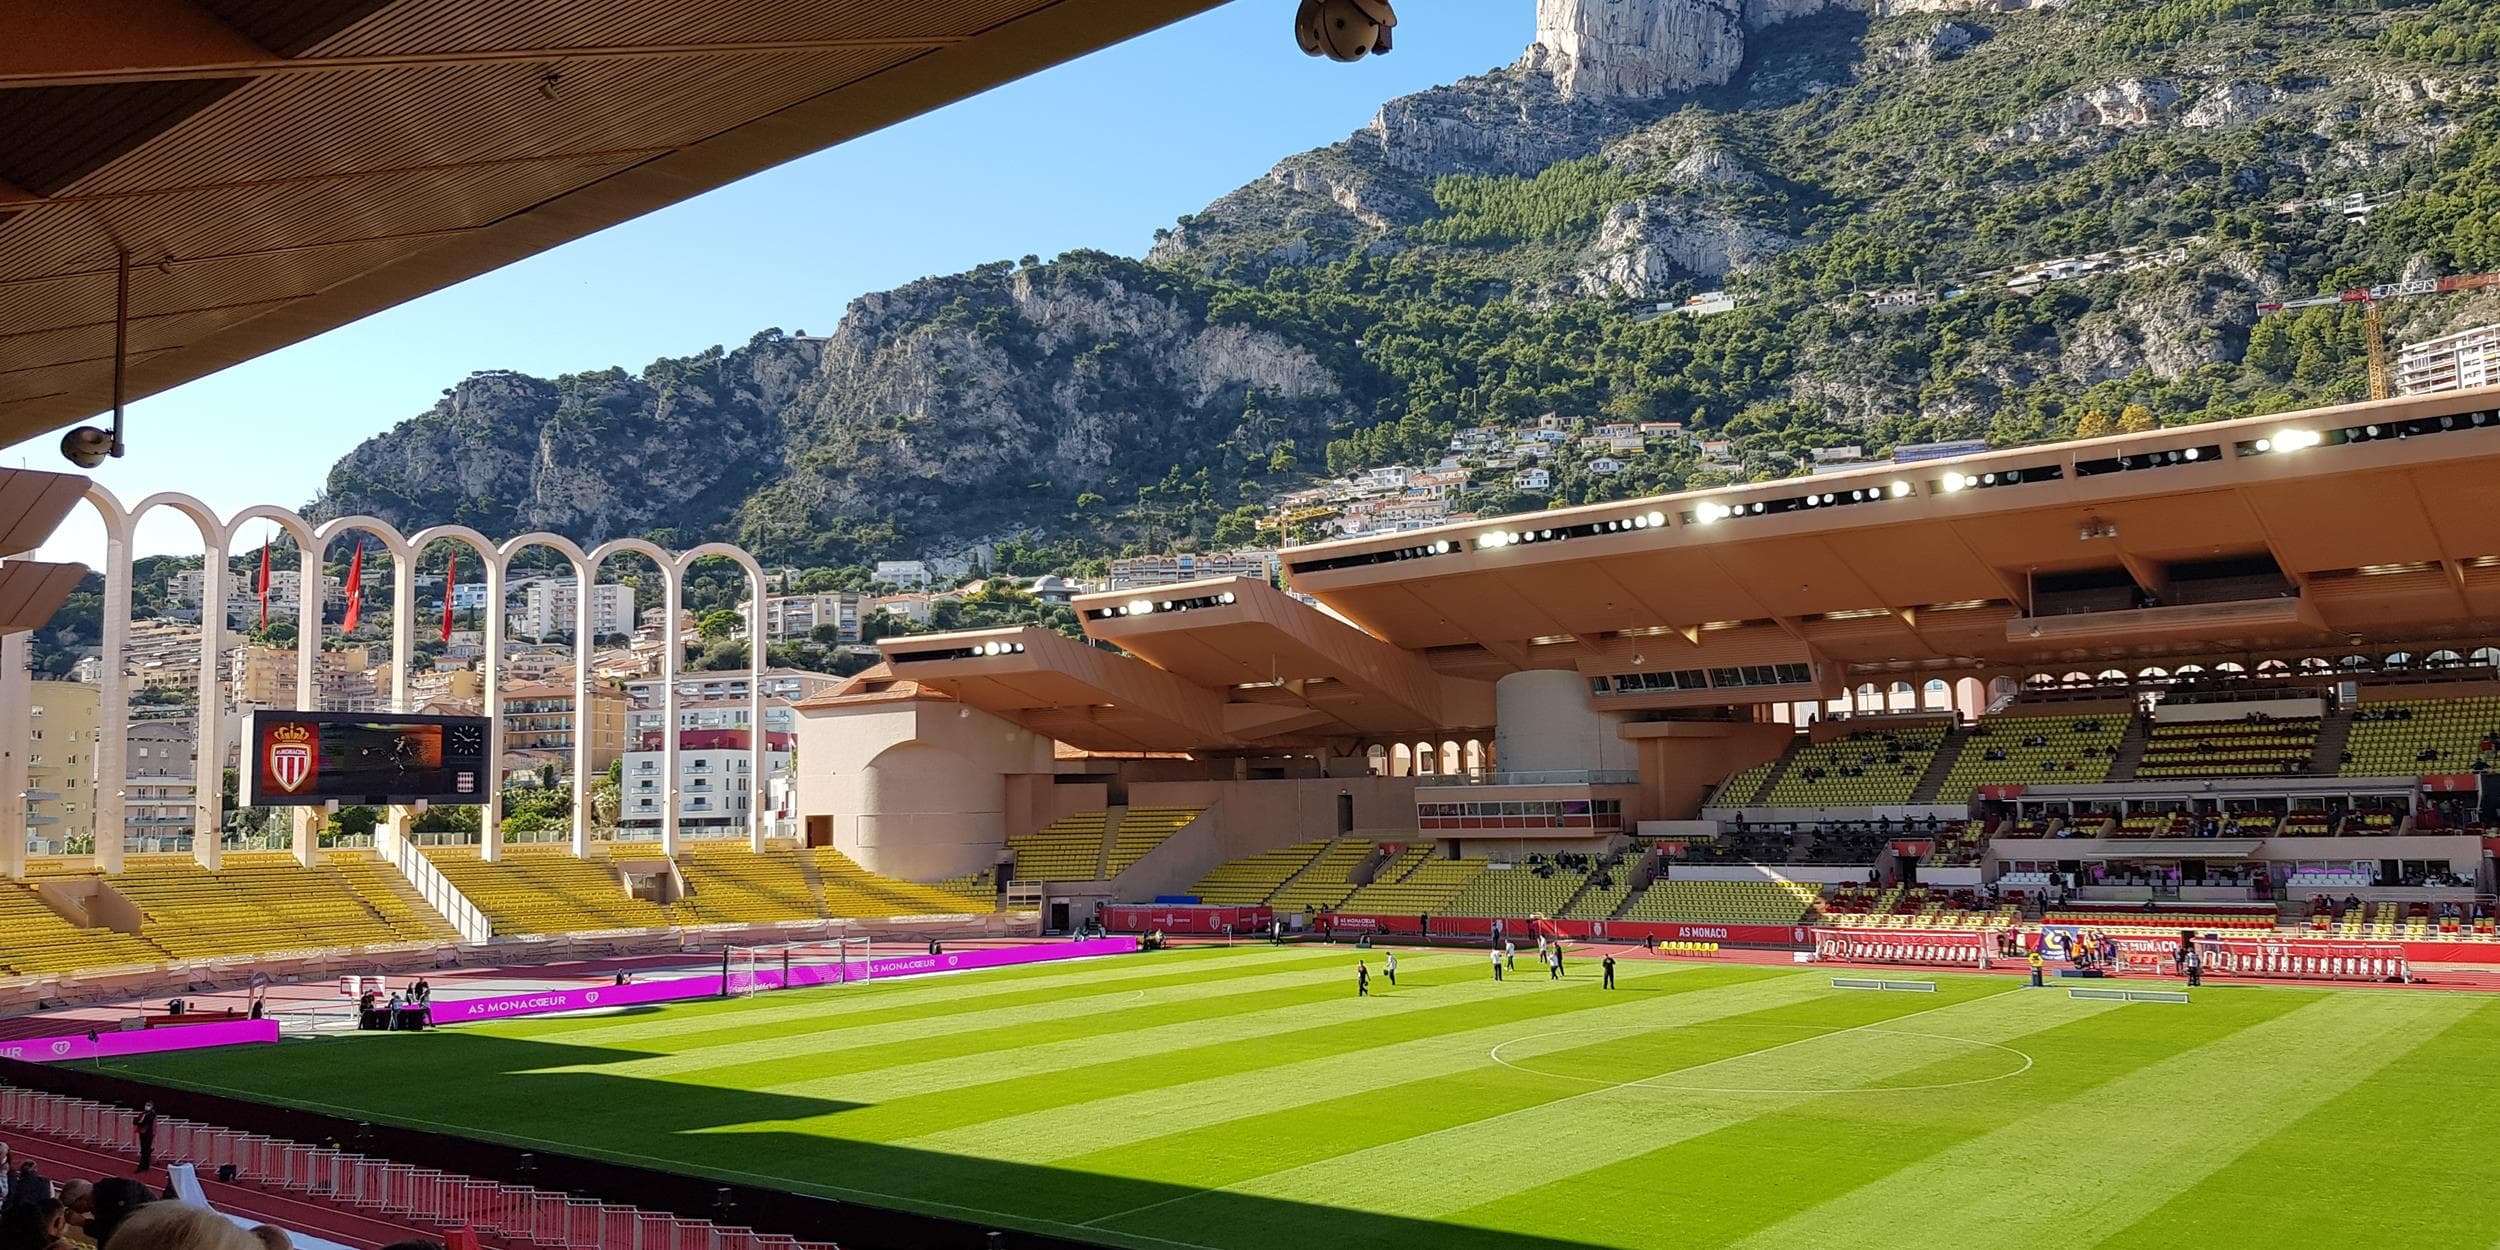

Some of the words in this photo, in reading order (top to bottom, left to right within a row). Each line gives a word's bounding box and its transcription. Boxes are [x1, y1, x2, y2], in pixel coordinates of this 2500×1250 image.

[1679, 926, 1691, 937] AS
[1692, 927, 1728, 938] MONACO
[468, 1003, 485, 1015] AS
